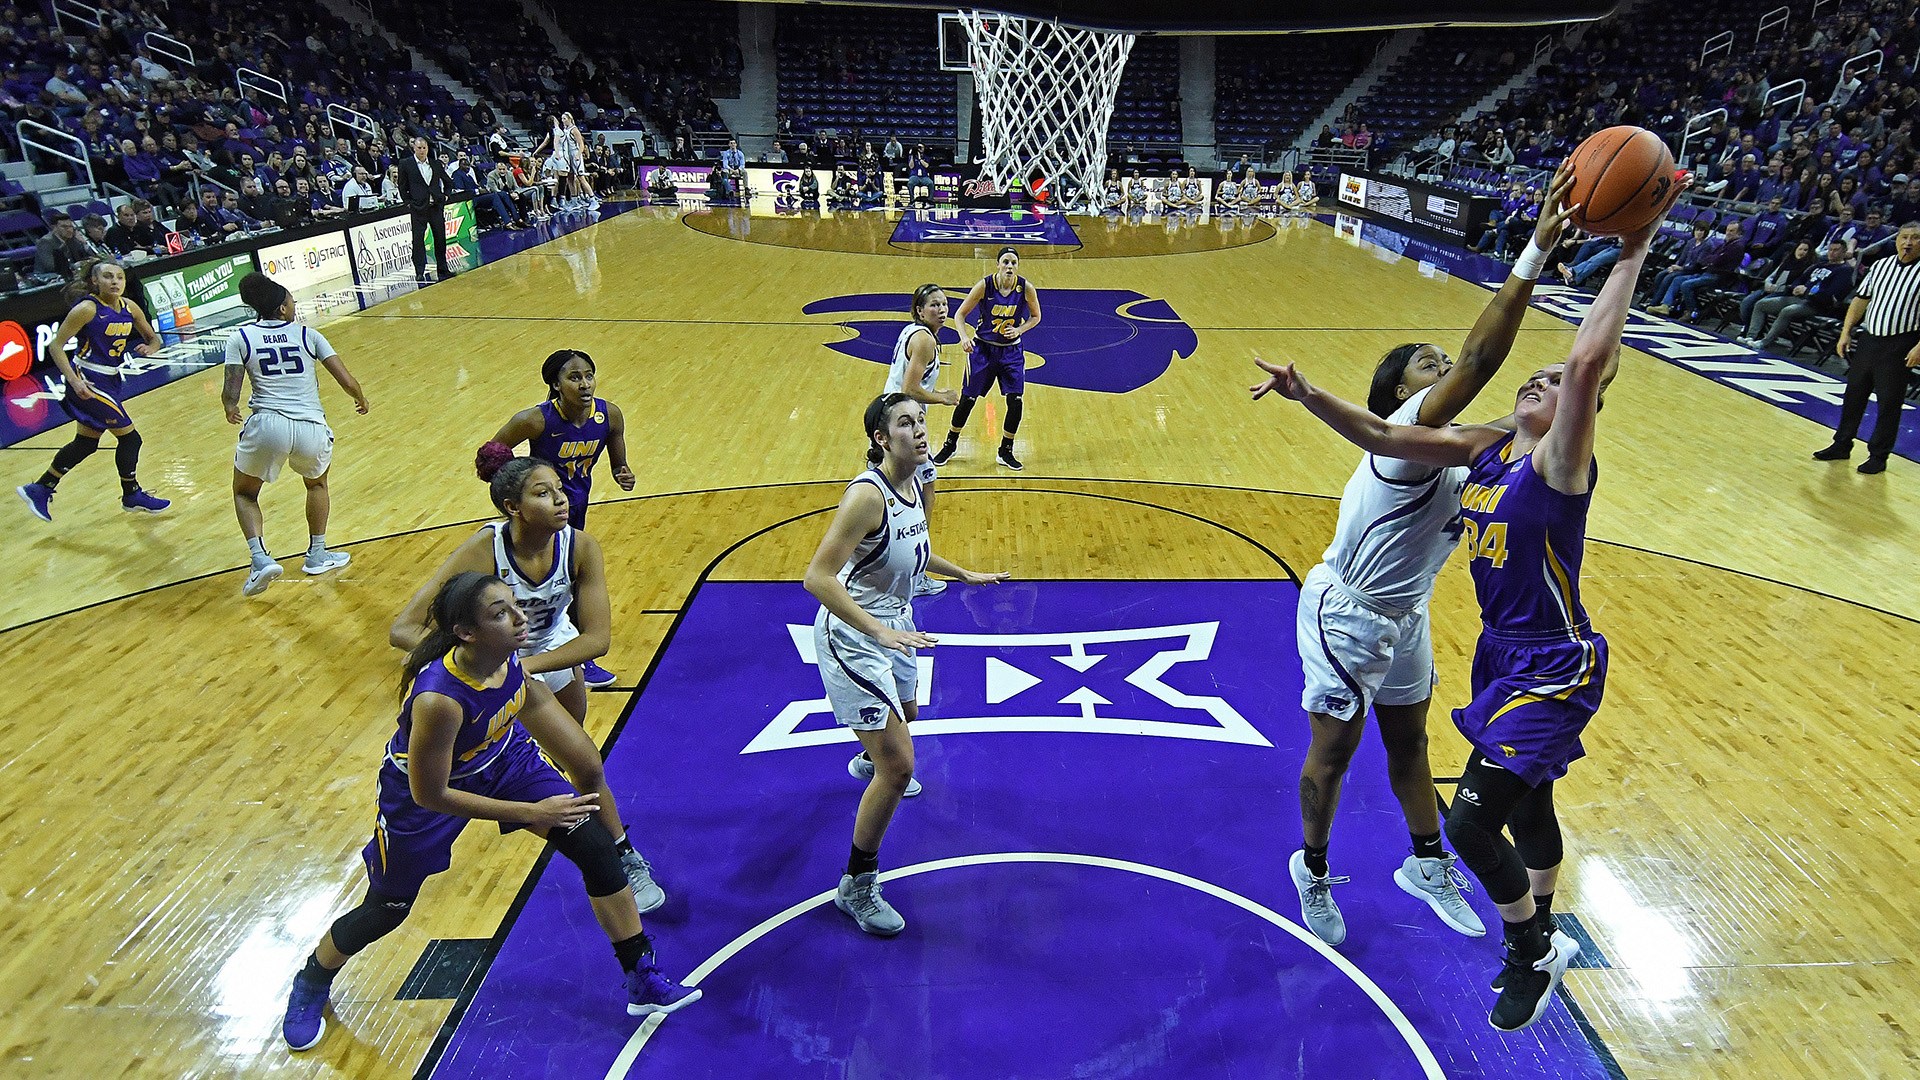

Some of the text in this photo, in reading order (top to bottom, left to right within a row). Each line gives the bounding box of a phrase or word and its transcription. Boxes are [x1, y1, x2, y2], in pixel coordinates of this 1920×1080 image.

[374, 219, 412, 242] Ascension
[376, 239, 413, 262] Via Chris
[263, 255, 296, 277] POINTE
[186, 260, 233, 296] THANK YOU
[201, 281, 229, 303] FARMERS
[991, 304, 1018, 317] UNI
[105, 322, 133, 336] UNI
[262, 333, 288, 344] BEARD
[108, 338, 127, 357] 3
[256, 346, 305, 376] 25
[558, 439, 600, 458] UNI
[1460, 482, 1509, 513] UNI
[911, 539, 930, 577] 11
